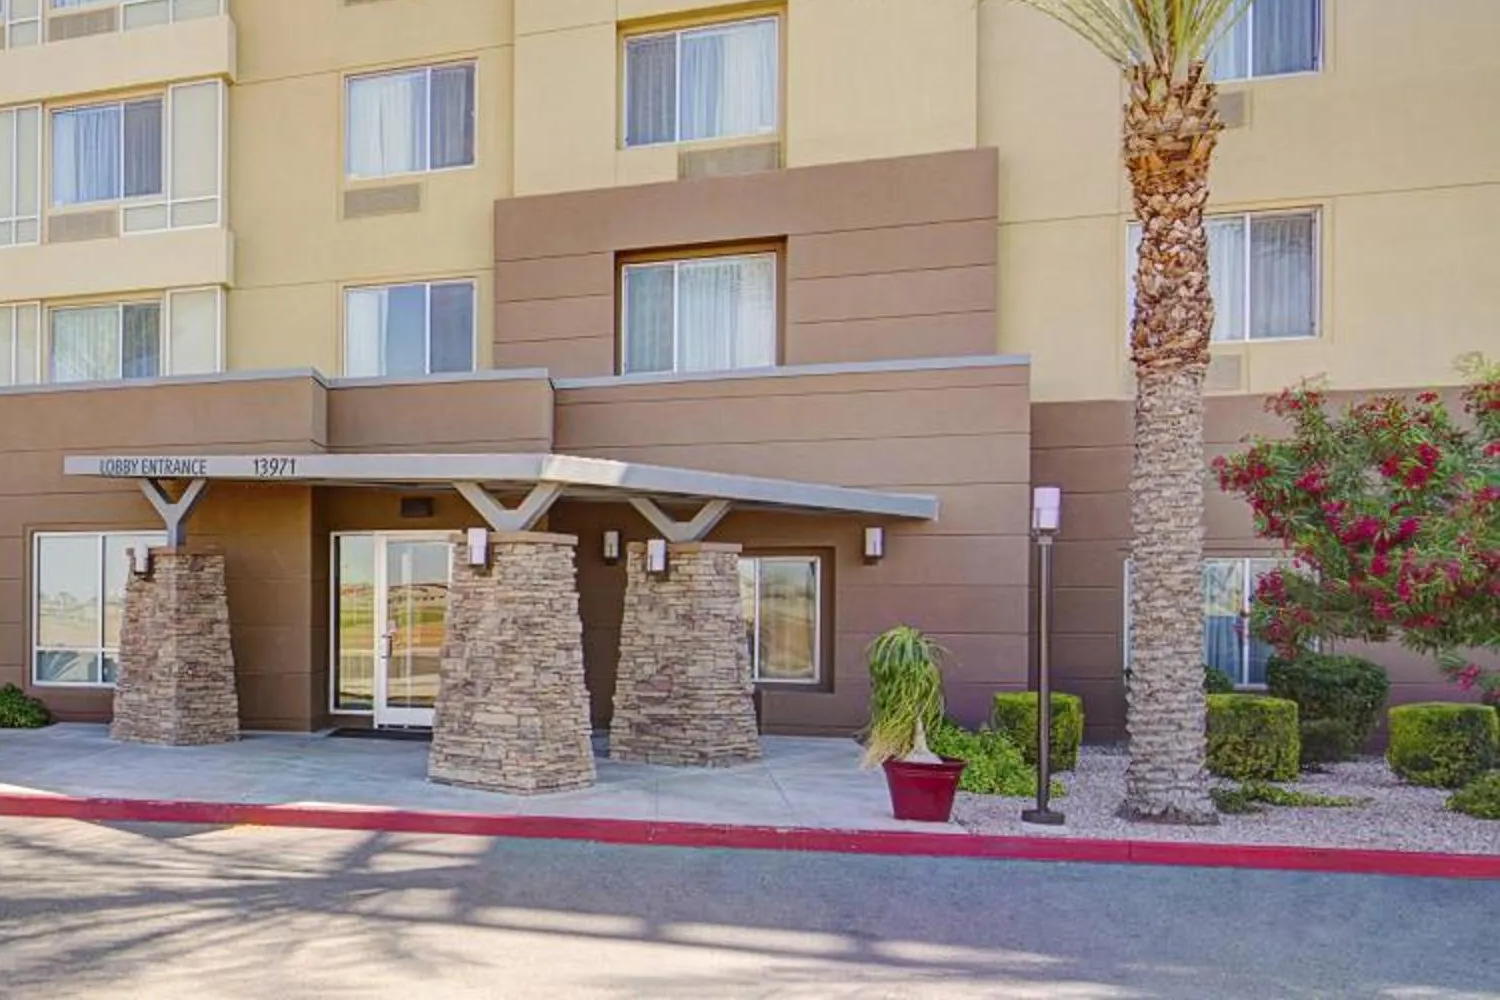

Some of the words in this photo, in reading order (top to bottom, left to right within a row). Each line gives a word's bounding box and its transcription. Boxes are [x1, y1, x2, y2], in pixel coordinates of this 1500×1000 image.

[100, 458, 138, 475] LOBBY
[141, 458, 207, 475] ENTRANCE
[253, 457, 297, 476] 13971
